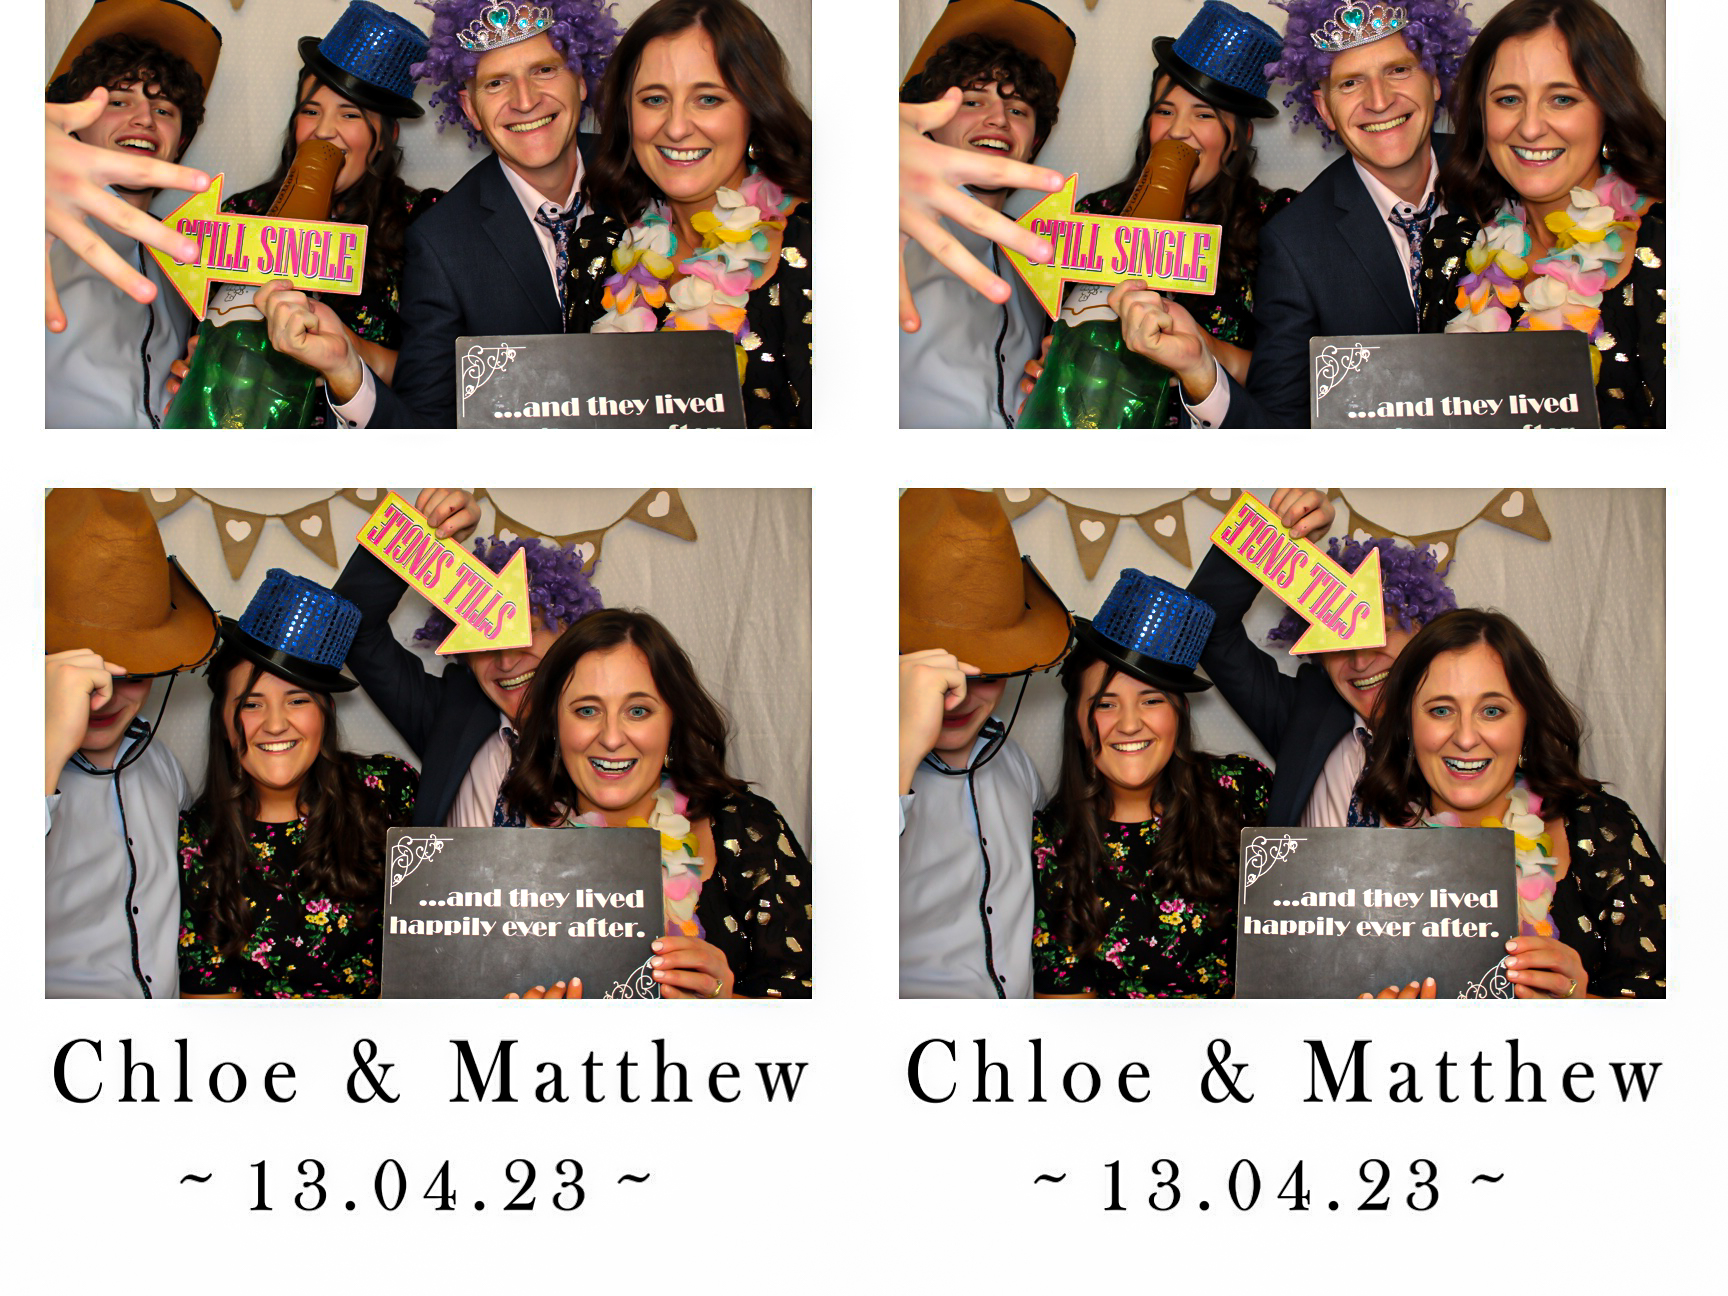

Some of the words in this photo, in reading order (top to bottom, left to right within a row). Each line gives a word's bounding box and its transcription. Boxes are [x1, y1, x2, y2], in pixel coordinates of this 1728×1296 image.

[257, 226, 357, 282] SINGLE
[1111, 226, 1211, 282] SINGLE
[586, 396, 649, 415] they
[655, 393, 725, 415] lived
[1440, 396, 1503, 415] they
[1509, 393, 1579, 415] lived
[367, 503, 454, 589] SINGLE
[1221, 503, 1308, 589] SINGLE
[443, 562, 516, 640] STILL
[1297, 562, 1370, 640] STILL
[508, 888, 570, 908] they
[576, 889, 644, 908] lived
[1362, 888, 1424, 908] they
[1430, 889, 1498, 908] lived
[389, 916, 497, 936] happily
[502, 920, 562, 937] ever
[567, 918, 646, 938] after.
[1243, 916, 1351, 936] happily
[1356, 920, 1416, 937] ever
[1421, 918, 1500, 938] after.
